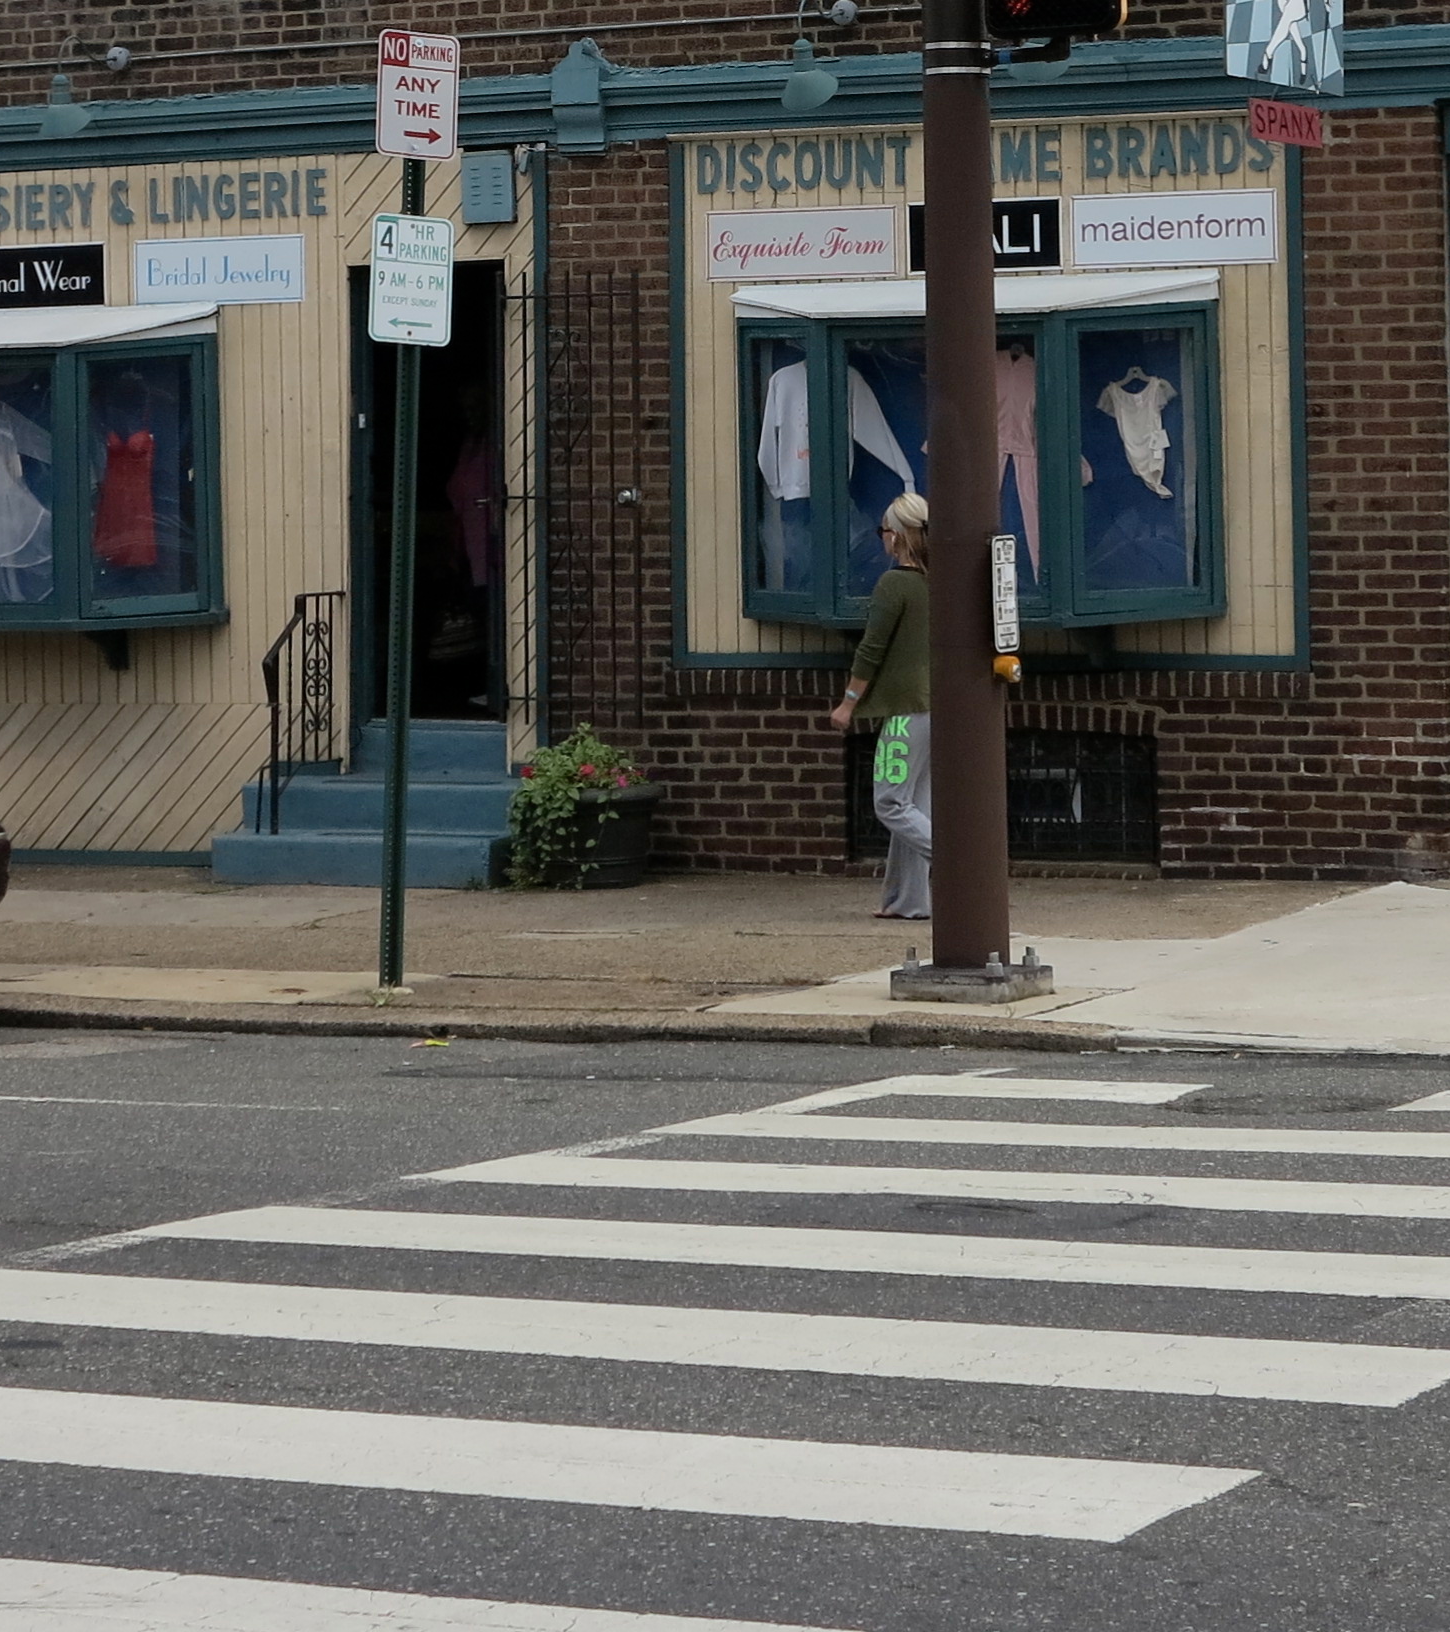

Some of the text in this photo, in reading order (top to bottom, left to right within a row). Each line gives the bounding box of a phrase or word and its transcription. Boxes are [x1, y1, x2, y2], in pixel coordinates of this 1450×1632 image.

[383, 36, 453, 63] NO PARKING
[395, 75, 441, 94] ANY
[394, 99, 441, 119] TIME
[1255, 102, 1318, 141] SPANX
[697, 135, 912, 195] DISCOUNT
[1085, 124, 1274, 180] BRANDS
[110, 179, 135, 226] &
[149, 168, 328, 224] LINGERIE
[415, 225, 435, 242] HR
[1081, 214, 1266, 242] maidenform
[380, 224, 447, 263] 4 PARKING
[712, 226, 889, 270] Exquisite Form
[33, 259, 91, 292] Wear
[148, 254, 291, 288] Bridal Jewelry
[378, 270, 386, 286] 9
[428, 275, 445, 292] PM
[382, 294, 438, 308] EXCEPT SUNDAY
